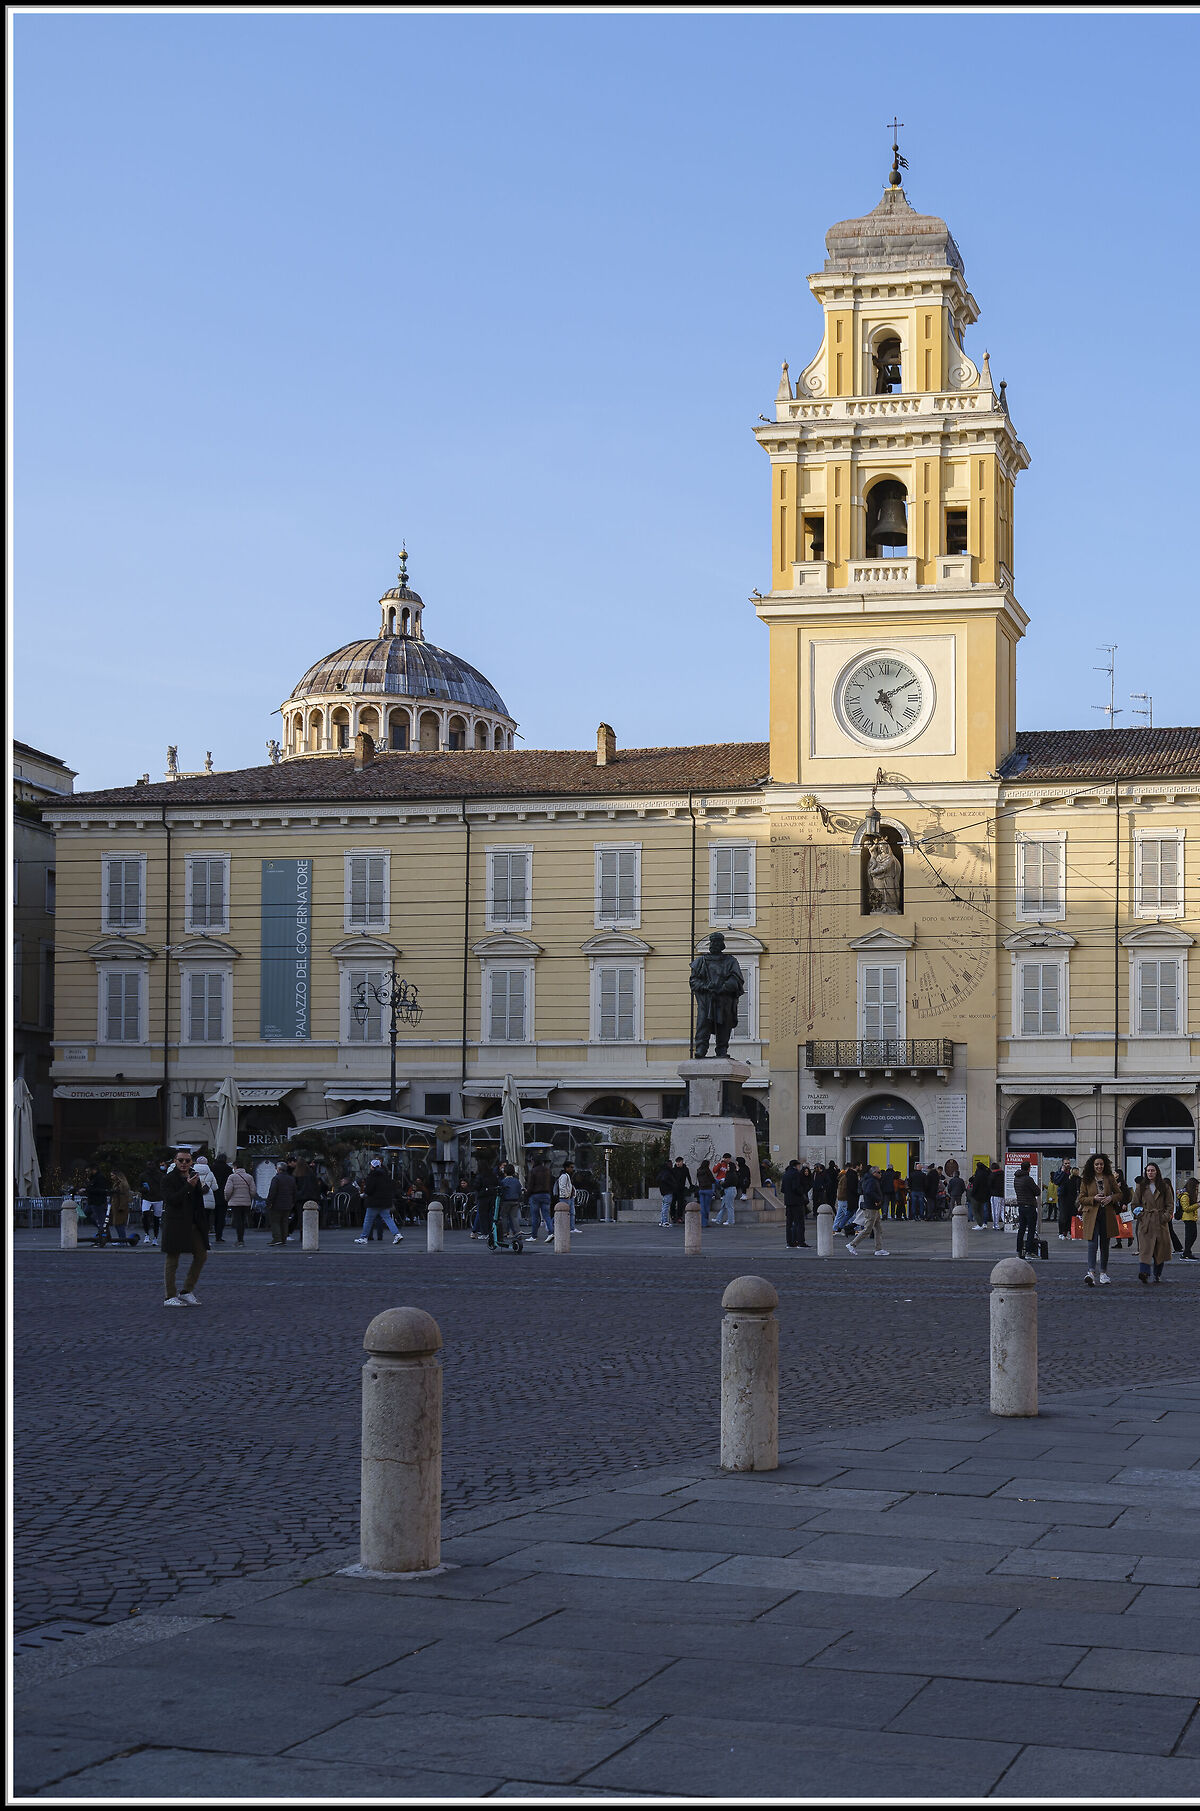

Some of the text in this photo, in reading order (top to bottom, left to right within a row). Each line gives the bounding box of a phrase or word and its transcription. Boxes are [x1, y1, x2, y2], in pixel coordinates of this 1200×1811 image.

[879, 664, 890, 676] XII
[296, 859, 309, 1038] PALAZZO DEL GOVERNATORE
[100, 1090, 141, 1098] OPTOMETRIA
